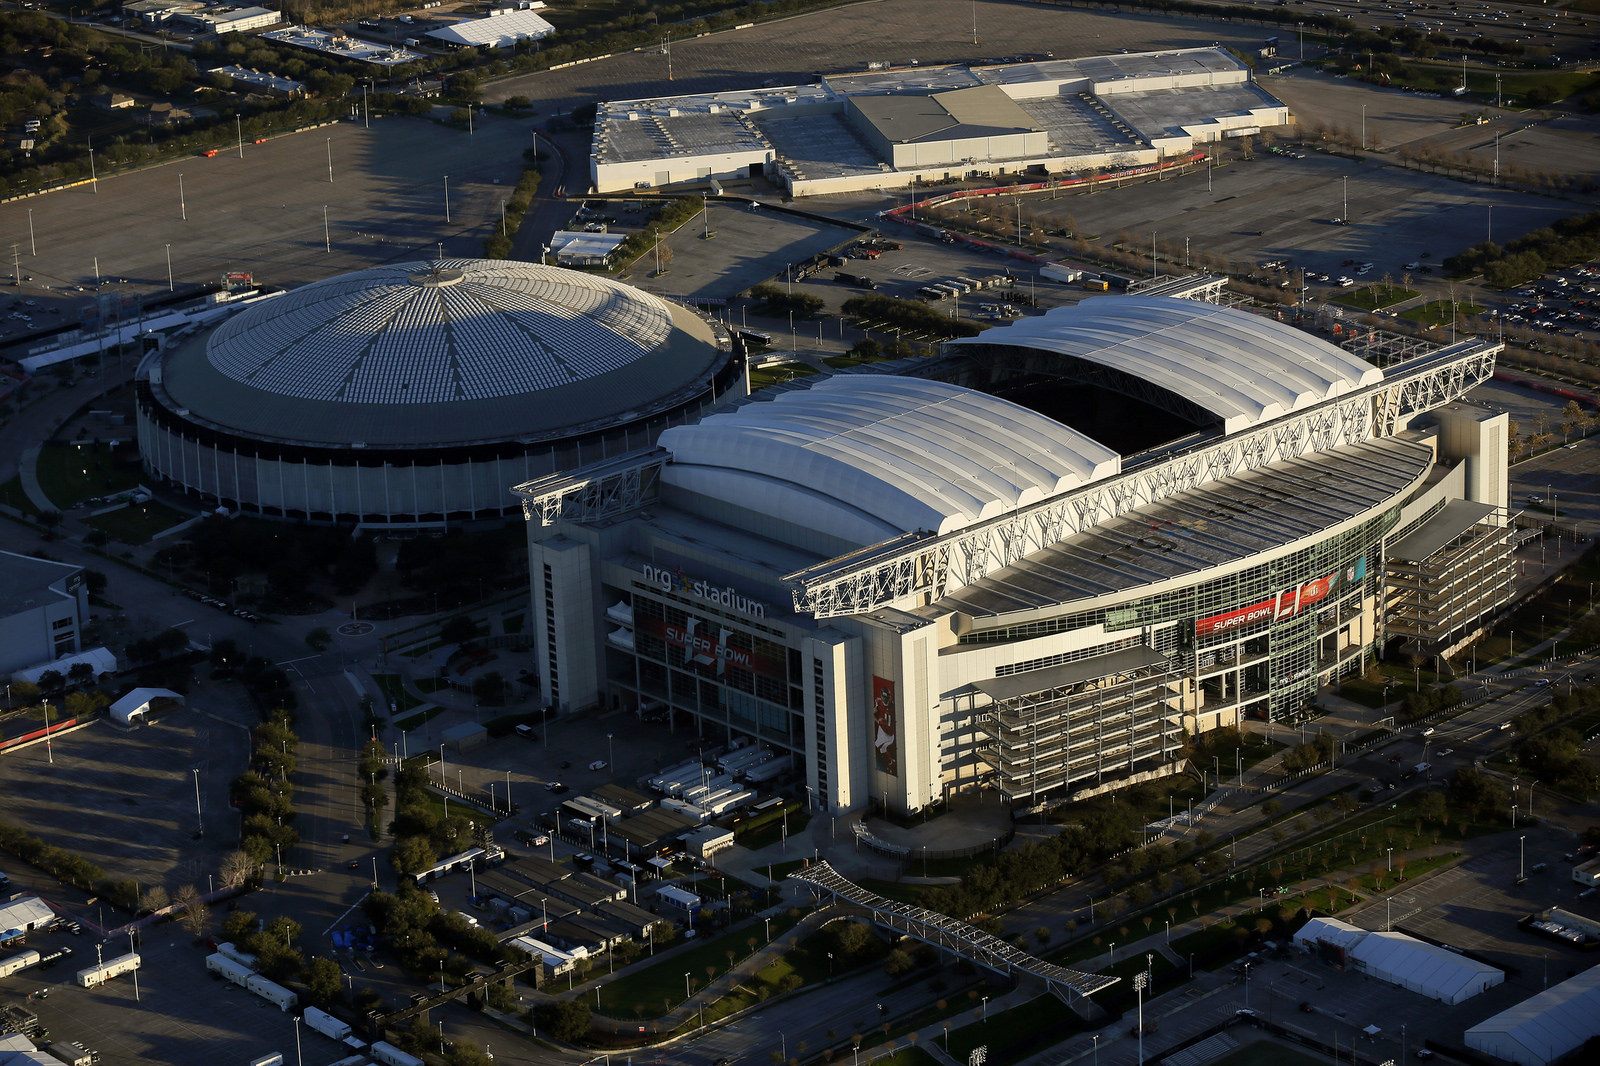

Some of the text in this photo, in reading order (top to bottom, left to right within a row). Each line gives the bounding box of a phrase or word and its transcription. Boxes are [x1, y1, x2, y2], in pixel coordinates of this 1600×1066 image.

[643, 564, 765, 619] nrg stadium
[1213, 615, 1245, 631] SUPER
[1247, 607, 1272, 621] BOWL
[665, 627, 751, 666] SUPER BOWL
